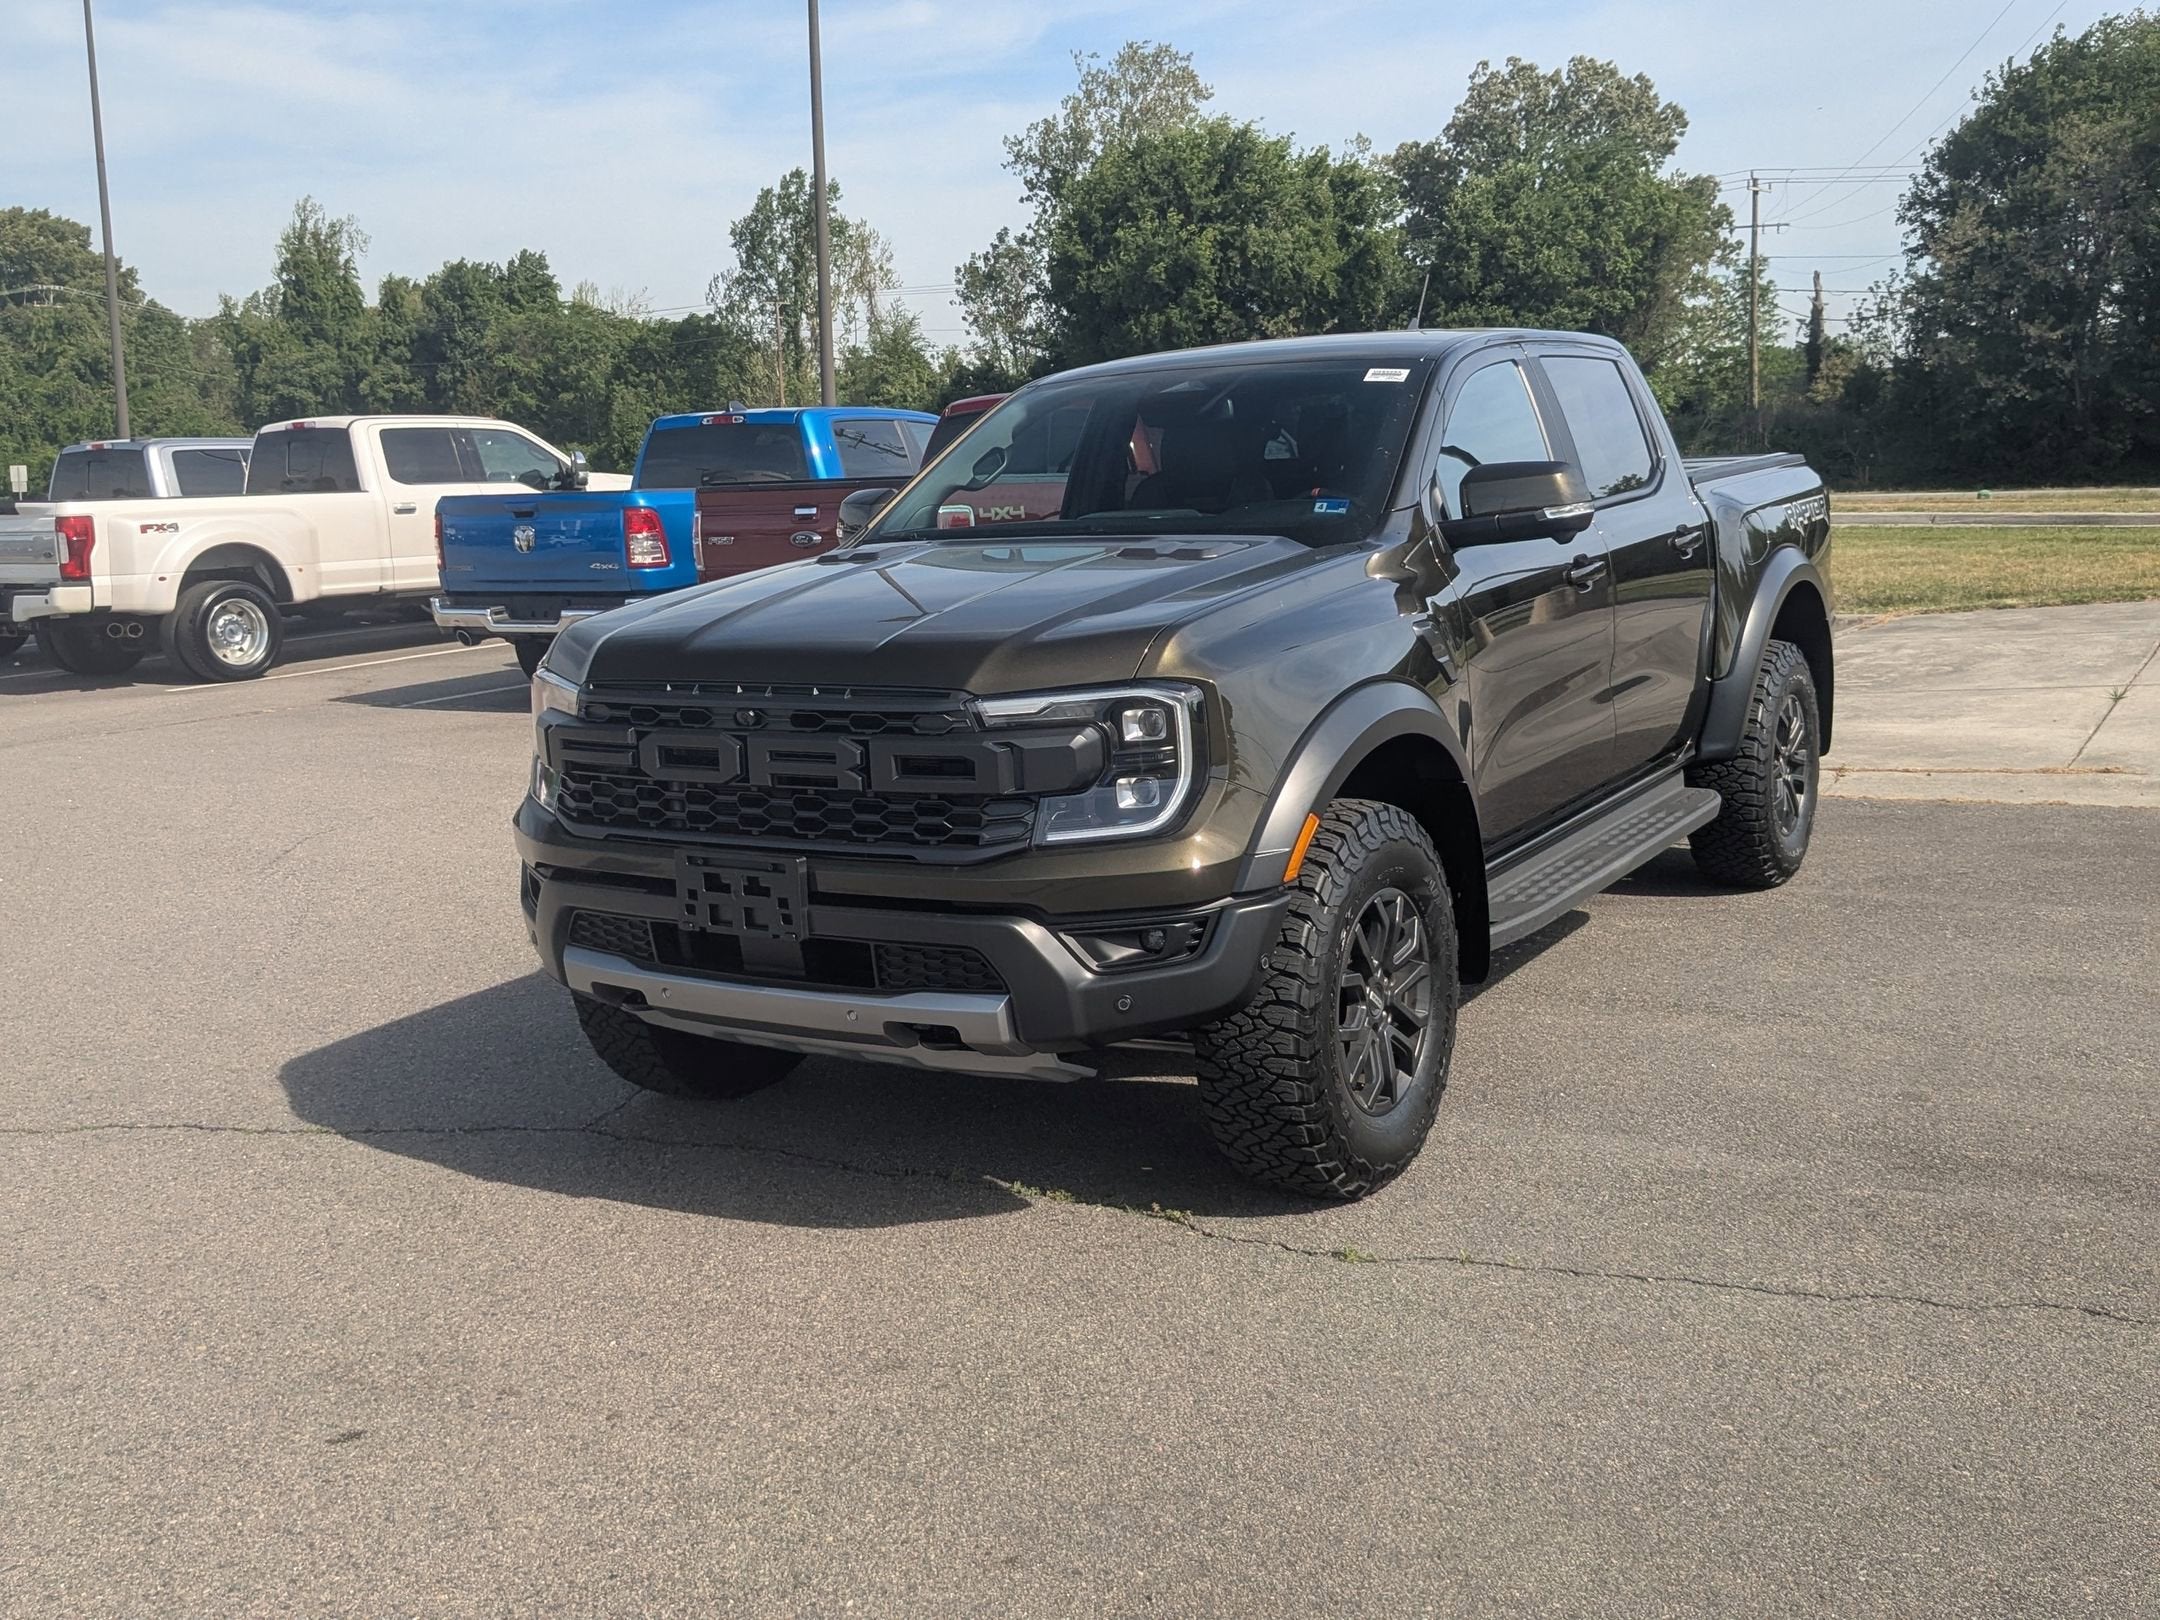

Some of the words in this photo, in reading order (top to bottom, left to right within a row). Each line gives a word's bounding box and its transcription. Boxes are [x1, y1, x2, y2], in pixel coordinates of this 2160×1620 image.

[139, 522, 179, 534] FX4
[1783, 494, 1829, 536] RAPTOR
[544, 723, 1015, 795] FORD
